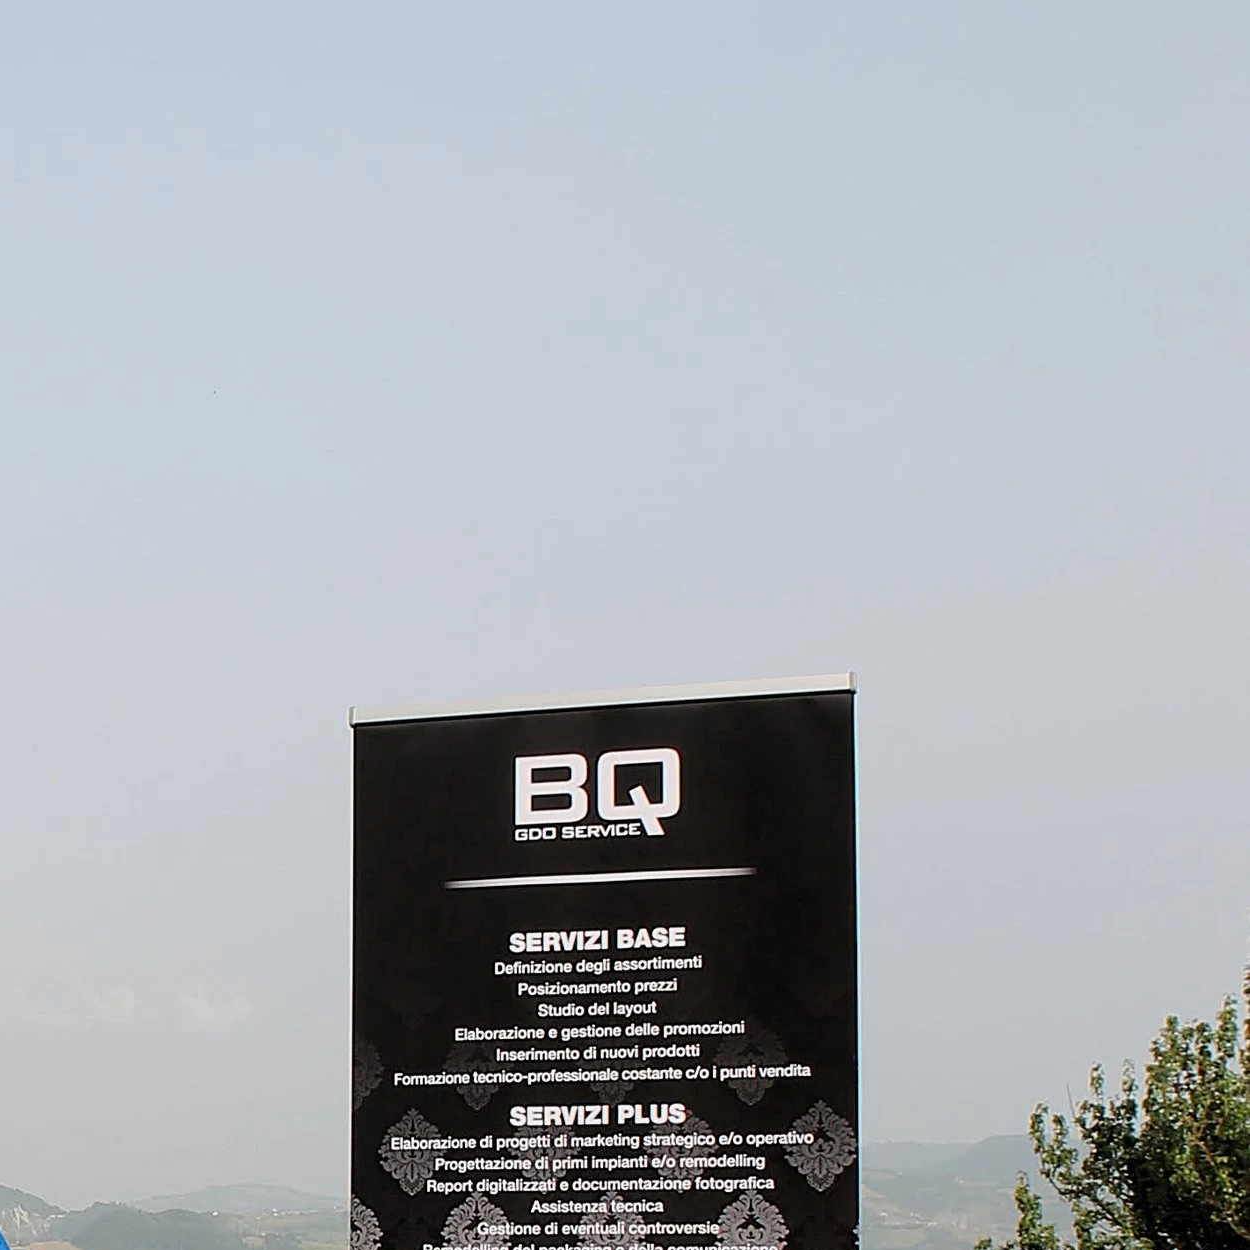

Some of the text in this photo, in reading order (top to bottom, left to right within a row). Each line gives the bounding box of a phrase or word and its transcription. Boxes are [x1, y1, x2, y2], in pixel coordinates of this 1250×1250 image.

[514, 747, 681, 836] BQ
[514, 823, 641, 841] GDO SERVICE
[509, 927, 686, 953] SERVIZI BASE
[494, 954, 703, 976] Definizione degli assortimenti
[518, 978, 678, 996] Posizionamento prezzi
[538, 1001, 657, 1018] Studio del layout
[455, 1021, 745, 1042] Elaborazione e gestione delle promozioni
[496, 1042, 700, 1062] Inserimento di nuovi prodotti
[394, 1063, 811, 1086] Formazione tecnico-professionale costante c/o i punti vendita
[509, 1103, 687, 1127] SERVIZI PLUS
[391, 1130, 814, 1153] Elaborazione di progetti di marketing strategico e/o operativo
[434, 1153, 766, 1172] Progettazione di primi impianti e/o remodelling
[426, 1175, 774, 1195] Report digitalizzati e documentazione fotografica
[531, 1198, 664, 1214] Assistenza tecnica
[477, 1220, 720, 1237] Gestione di eventuali controversie
